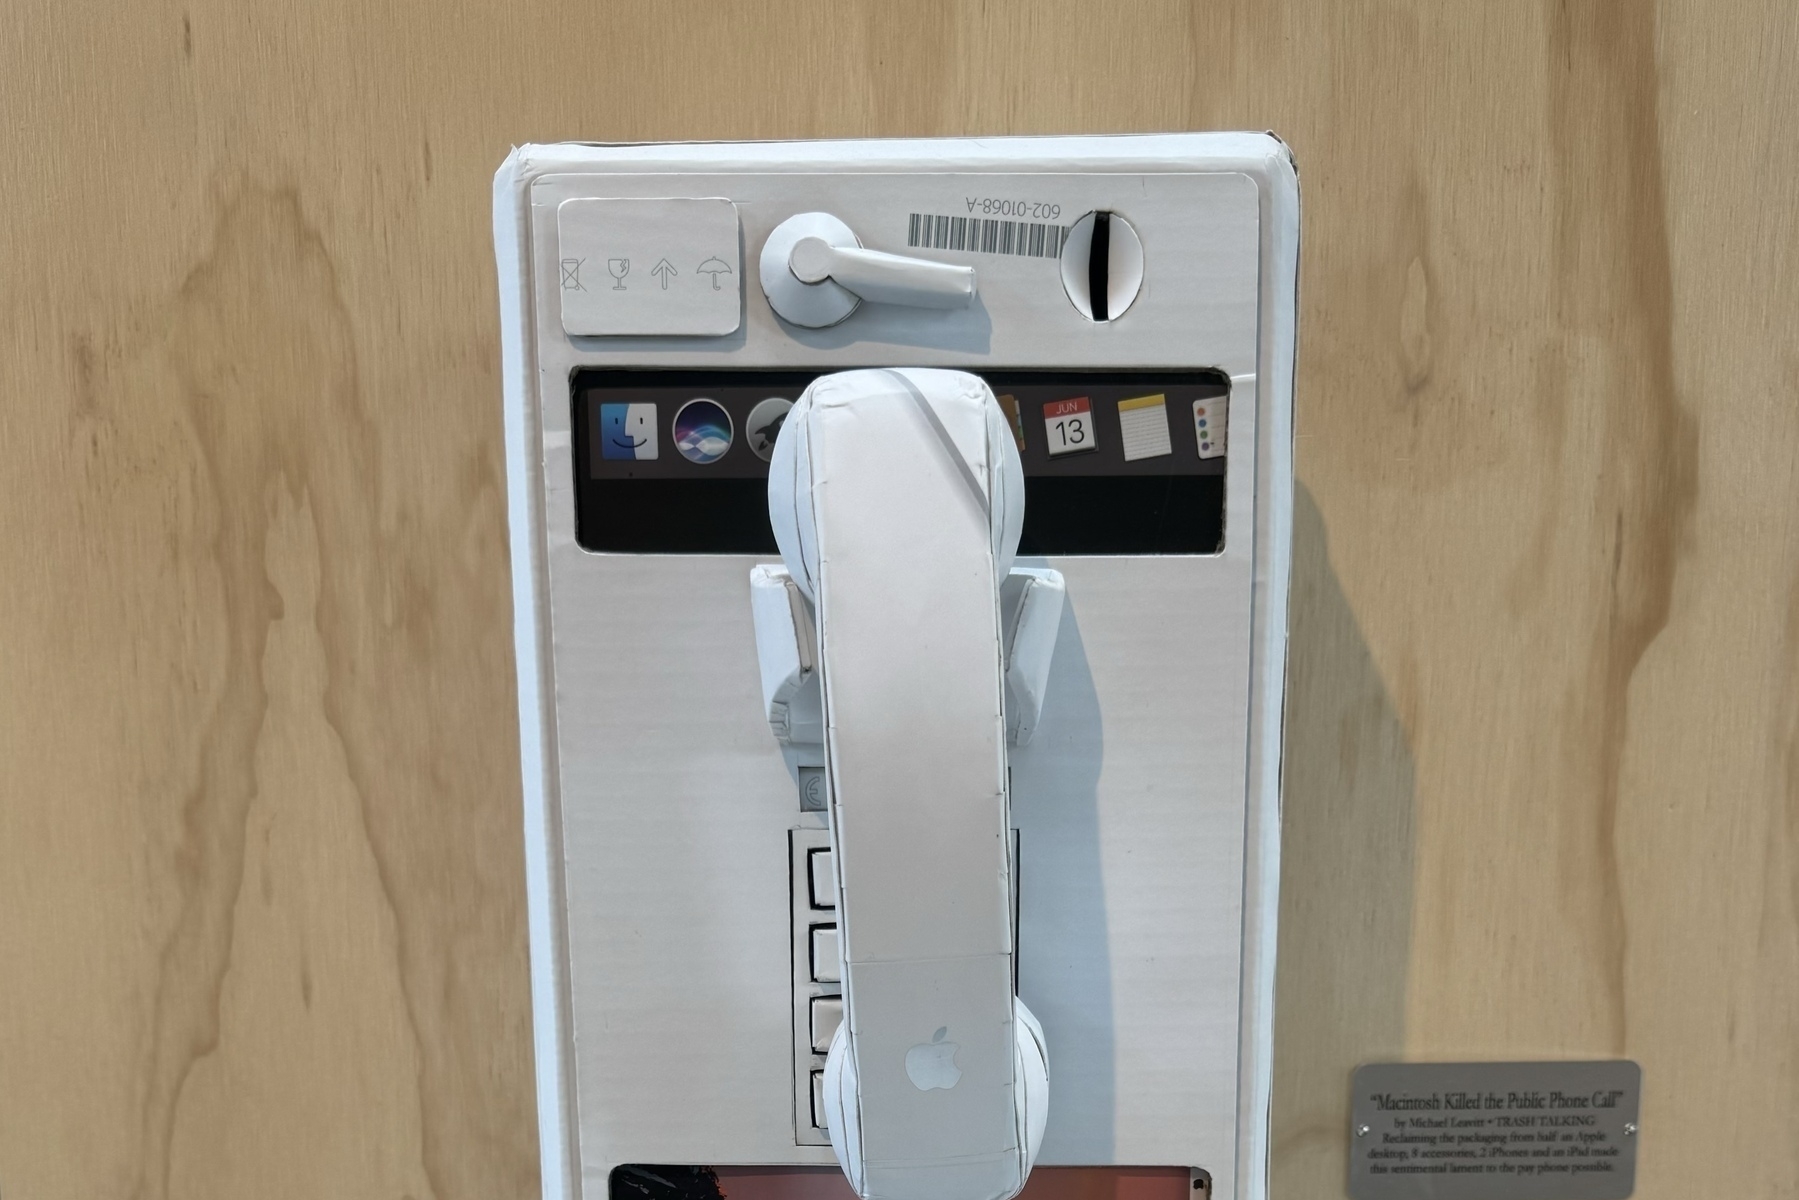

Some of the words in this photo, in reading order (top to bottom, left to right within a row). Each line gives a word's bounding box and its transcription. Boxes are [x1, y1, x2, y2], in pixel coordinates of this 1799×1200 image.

[965, 197, 1061, 220] 602-01068-A
[1055, 402, 1078, 415] JUN
[1055, 418, 1085, 447] 13
[1443, 1091, 1482, 1110] Killed
[1484, 1092, 1504, 1110] the
[1507, 1091, 1546, 1110] Public
[1549, 1091, 1588, 1109] Phone
[1394, 1118, 1406, 1130] by
[1409, 1117, 1447, 1128] Michael
[1450, 1117, 1484, 1128] Leavitt
[1494, 1116, 1536, 1127] TRASH
[1538, 1115, 1595, 1127] TALKING
[1382, 1132, 1436, 1146] Reclaiming
[1439, 1132, 1455, 1144] the
[1457, 1132, 1507, 1147] packaging
[1510, 1131, 1534, 1143] from
[1561, 1134, 1574, 1142] an
[1576, 1130, 1606, 1144] Apple
[1367, 1148, 1409, 1162] desktop,
[1480, 1147, 1488, 1158] 2
[1489, 1146, 1529, 1158] iPhones
[1532, 1146, 1551, 1157] and
[1552, 1149, 1566, 1157] an
[1567, 1145, 1590, 1157] iPad
[1591, 1146, 1619, 1157] made
[1369, 1163, 1388, 1175] this
[1390, 1163, 1447, 1175] sentimental
[1449, 1163, 1483, 1174] lament
[1485, 1164, 1498, 1174] to
[1499, 1162, 1516, 1173] the
[1517, 1165, 1535, 1177] pay
[1537, 1162, 1570, 1176] phone
